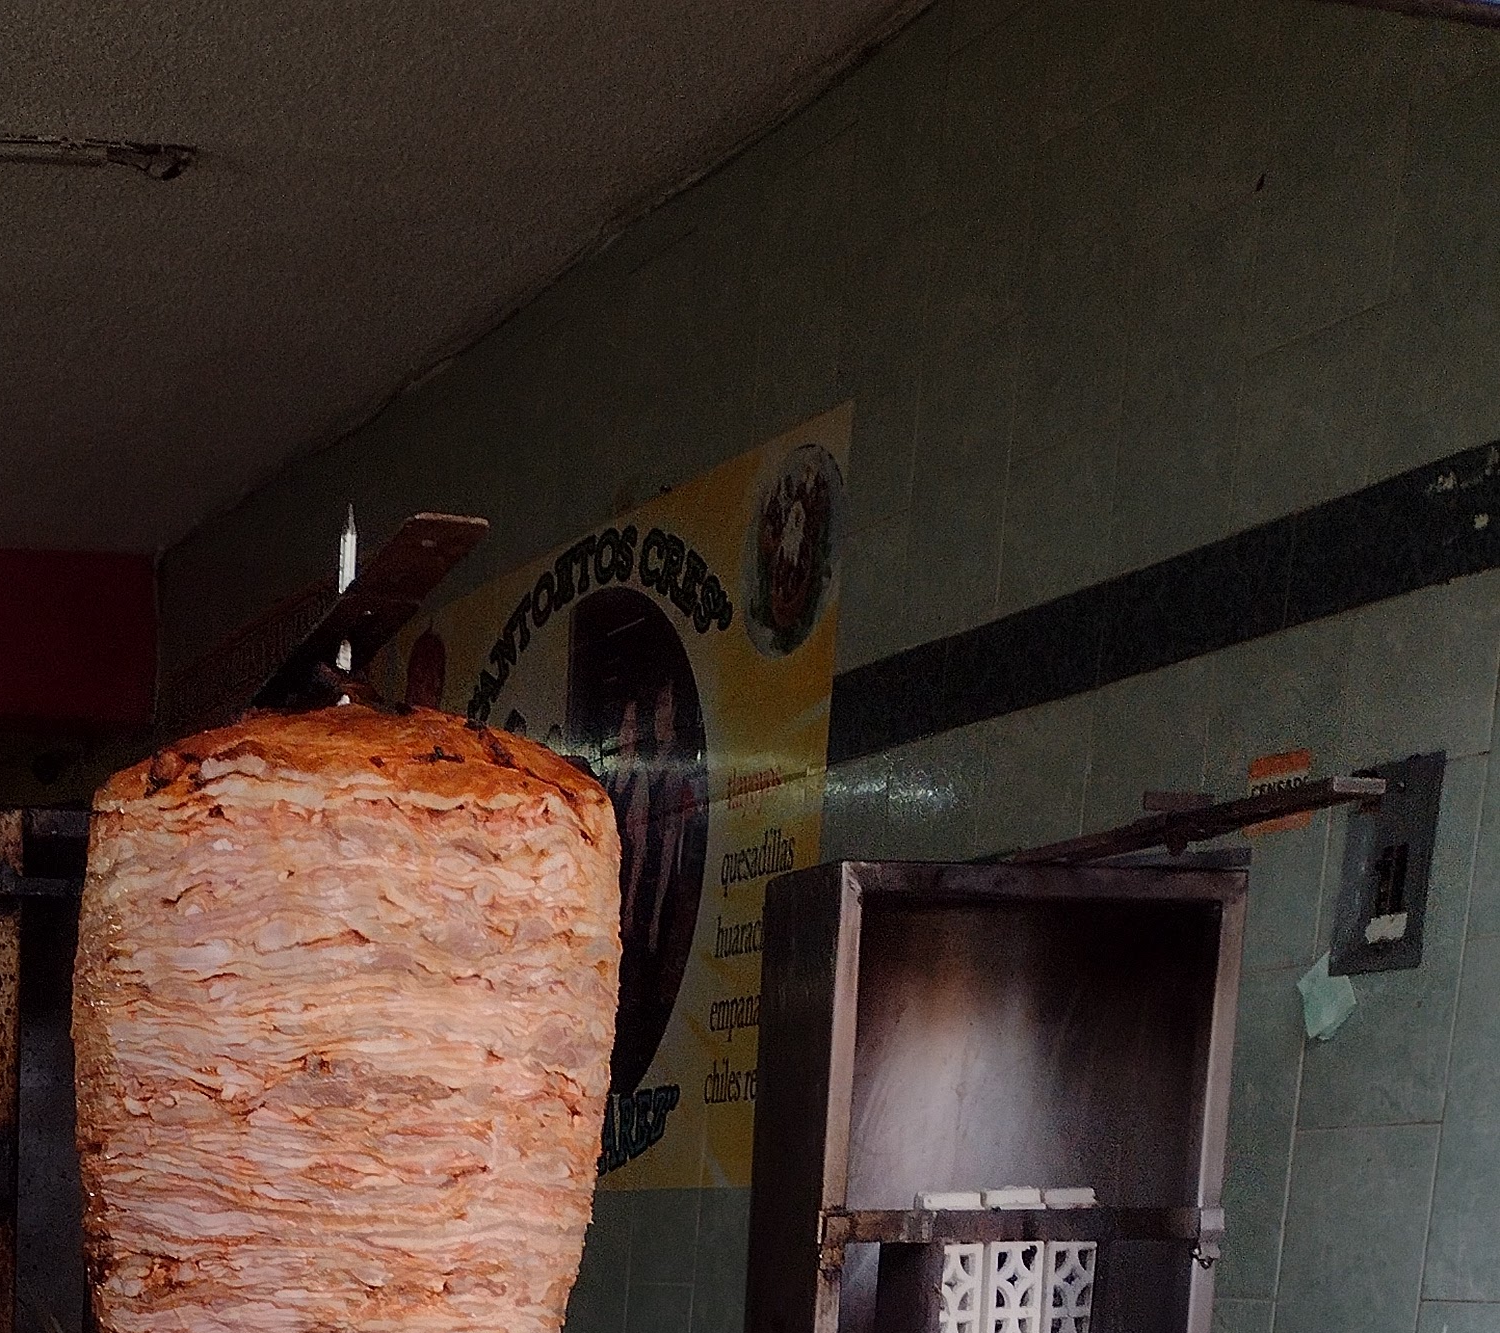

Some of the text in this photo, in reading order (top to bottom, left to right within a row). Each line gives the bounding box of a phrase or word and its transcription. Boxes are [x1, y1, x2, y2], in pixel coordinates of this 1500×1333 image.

[720, 829, 795, 897] quesadillas
[714, 915, 765, 958] huarac
[704, 1057, 741, 1104] chiles
